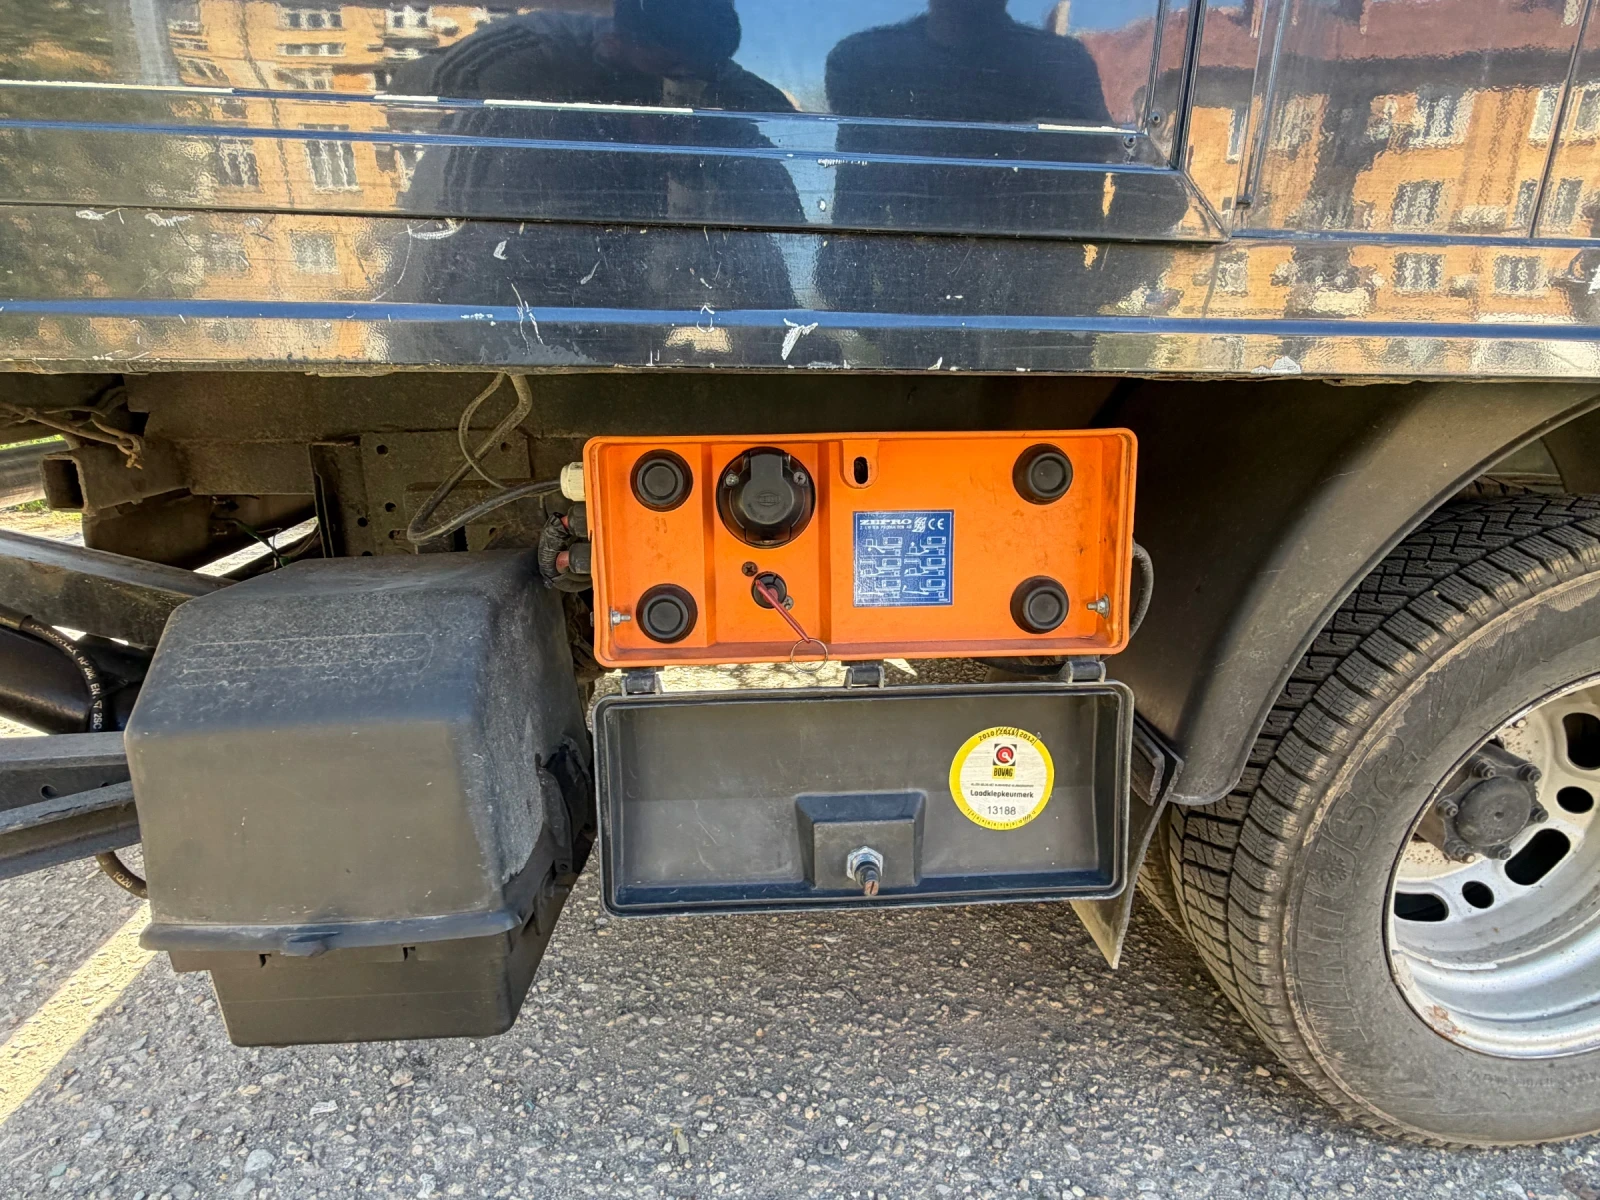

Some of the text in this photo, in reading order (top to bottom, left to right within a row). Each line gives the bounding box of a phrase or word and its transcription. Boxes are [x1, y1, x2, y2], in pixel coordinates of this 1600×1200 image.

[978, 731, 995, 741] 2010
[1019, 732, 1035, 743] 2012
[994, 768, 1013, 777] BOVAG
[988, 805, 1016, 815] 13188
